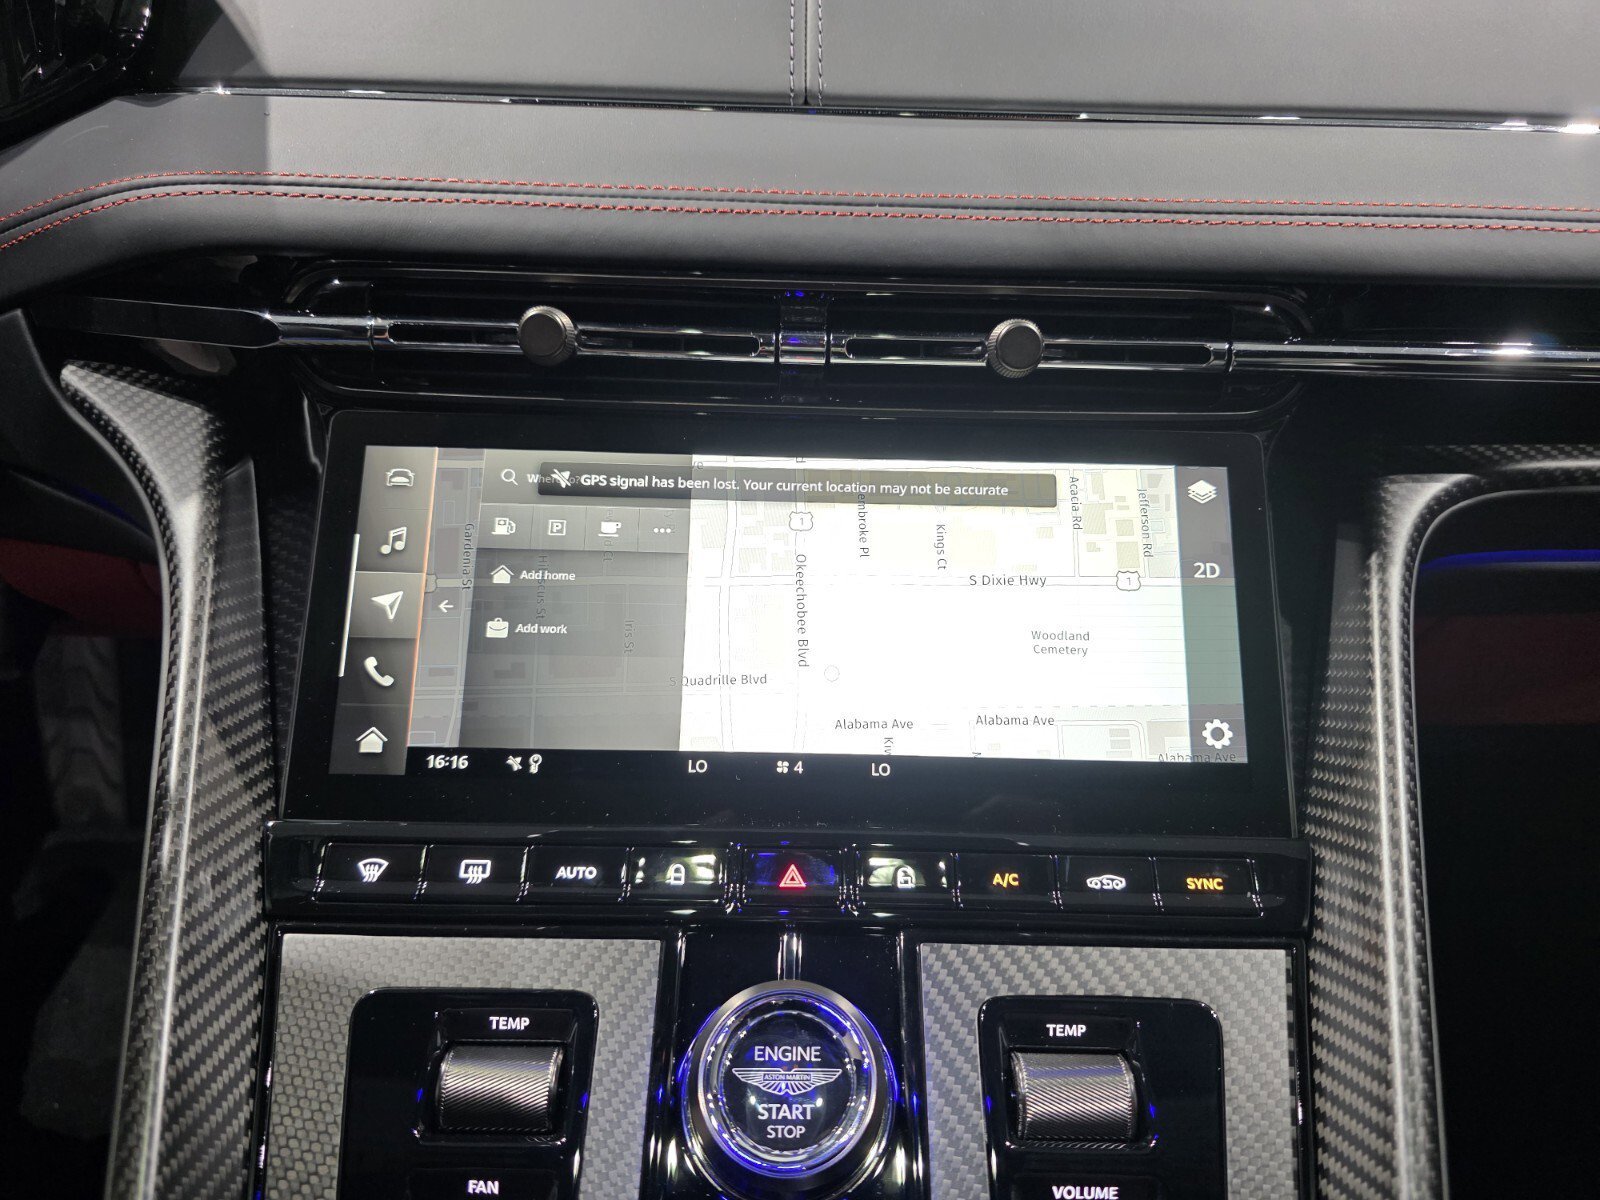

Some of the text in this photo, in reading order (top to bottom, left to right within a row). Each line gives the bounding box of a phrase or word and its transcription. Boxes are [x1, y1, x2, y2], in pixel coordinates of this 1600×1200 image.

[580, 474, 1009, 497] GPS signal has been lost. Your current location may not be accurate
[1069, 476, 1084, 530] Acacia Rd
[857, 493, 870, 558] embroke Pl
[1136, 488, 1154, 558] Jefferson Rd
[934, 524, 948, 570] Kings Ct
[461, 523, 475, 591] Gardenia St
[520, 569, 576, 582] Add home
[1193, 562, 1220, 579] 2D
[536, 555, 549, 620] Hiscus St
[969, 574, 1047, 588] S Dixie Hwy
[795, 554, 809, 667] Okeechobee Blvd
[514, 623, 568, 635] Add work
[1031, 630, 1090, 641] Woodland
[623, 620, 635, 654] Iris St
[1033, 644, 1088, 657] Cemetery
[669, 673, 768, 688] S Quadrille Blvd
[835, 718, 914, 730] Alabama Ave
[975, 714, 1055, 726] Alabama Ave
[426, 754, 469, 770] 16:16
[1214, 752, 1237, 762] Ave
[688, 760, 708, 774] LO
[793, 761, 804, 775] 4
[871, 762, 891, 777] LO
[555, 865, 597, 880] AUTO
[992, 872, 1019, 888] A/C
[1186, 877, 1224, 891] SYNC
[489, 1016, 530, 1031] TEMP
[1046, 1024, 1087, 1037] TEMP
[754, 1045, 821, 1062] ENGINE
[763, 1073, 811, 1081] ASTON MARTIN
[757, 1103, 816, 1120] START
[766, 1125, 806, 1139] STOP
[467, 1180, 499, 1194] FAN
[1051, 1185, 1119, 1200] VOLUME
